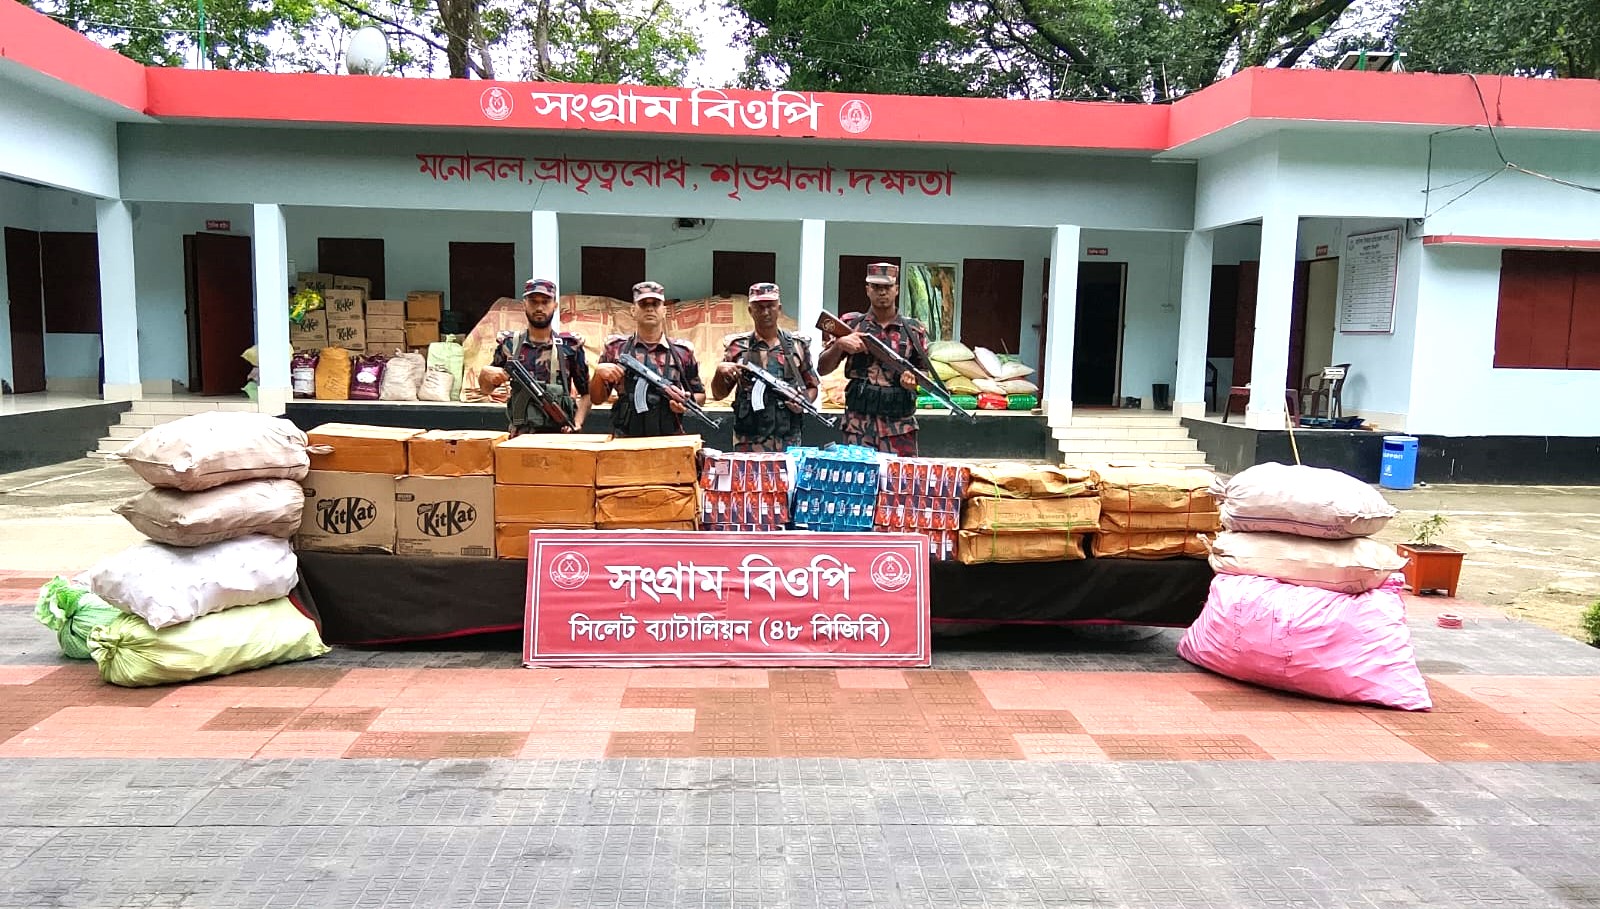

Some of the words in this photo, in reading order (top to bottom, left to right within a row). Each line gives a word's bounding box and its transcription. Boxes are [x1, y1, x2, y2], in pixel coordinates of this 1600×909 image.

[531, 89, 682, 126] সংগ্রাম
[689, 88, 824, 131] বিওপি
[845, 163, 957, 196] দক্ষতা
[323, 497, 375, 534] KitKat
[424, 501, 475, 537] KitKat
[604, 560, 729, 602] সংগ্রাম
[739, 554, 856, 600] বিওপি
[568, 613, 638, 642] সিলেট
[644, 613, 751, 644] ব্যাটালিয়ন
[759, 617, 802, 647] (৪৮
[812, 614, 890, 647] বিজিবি)
